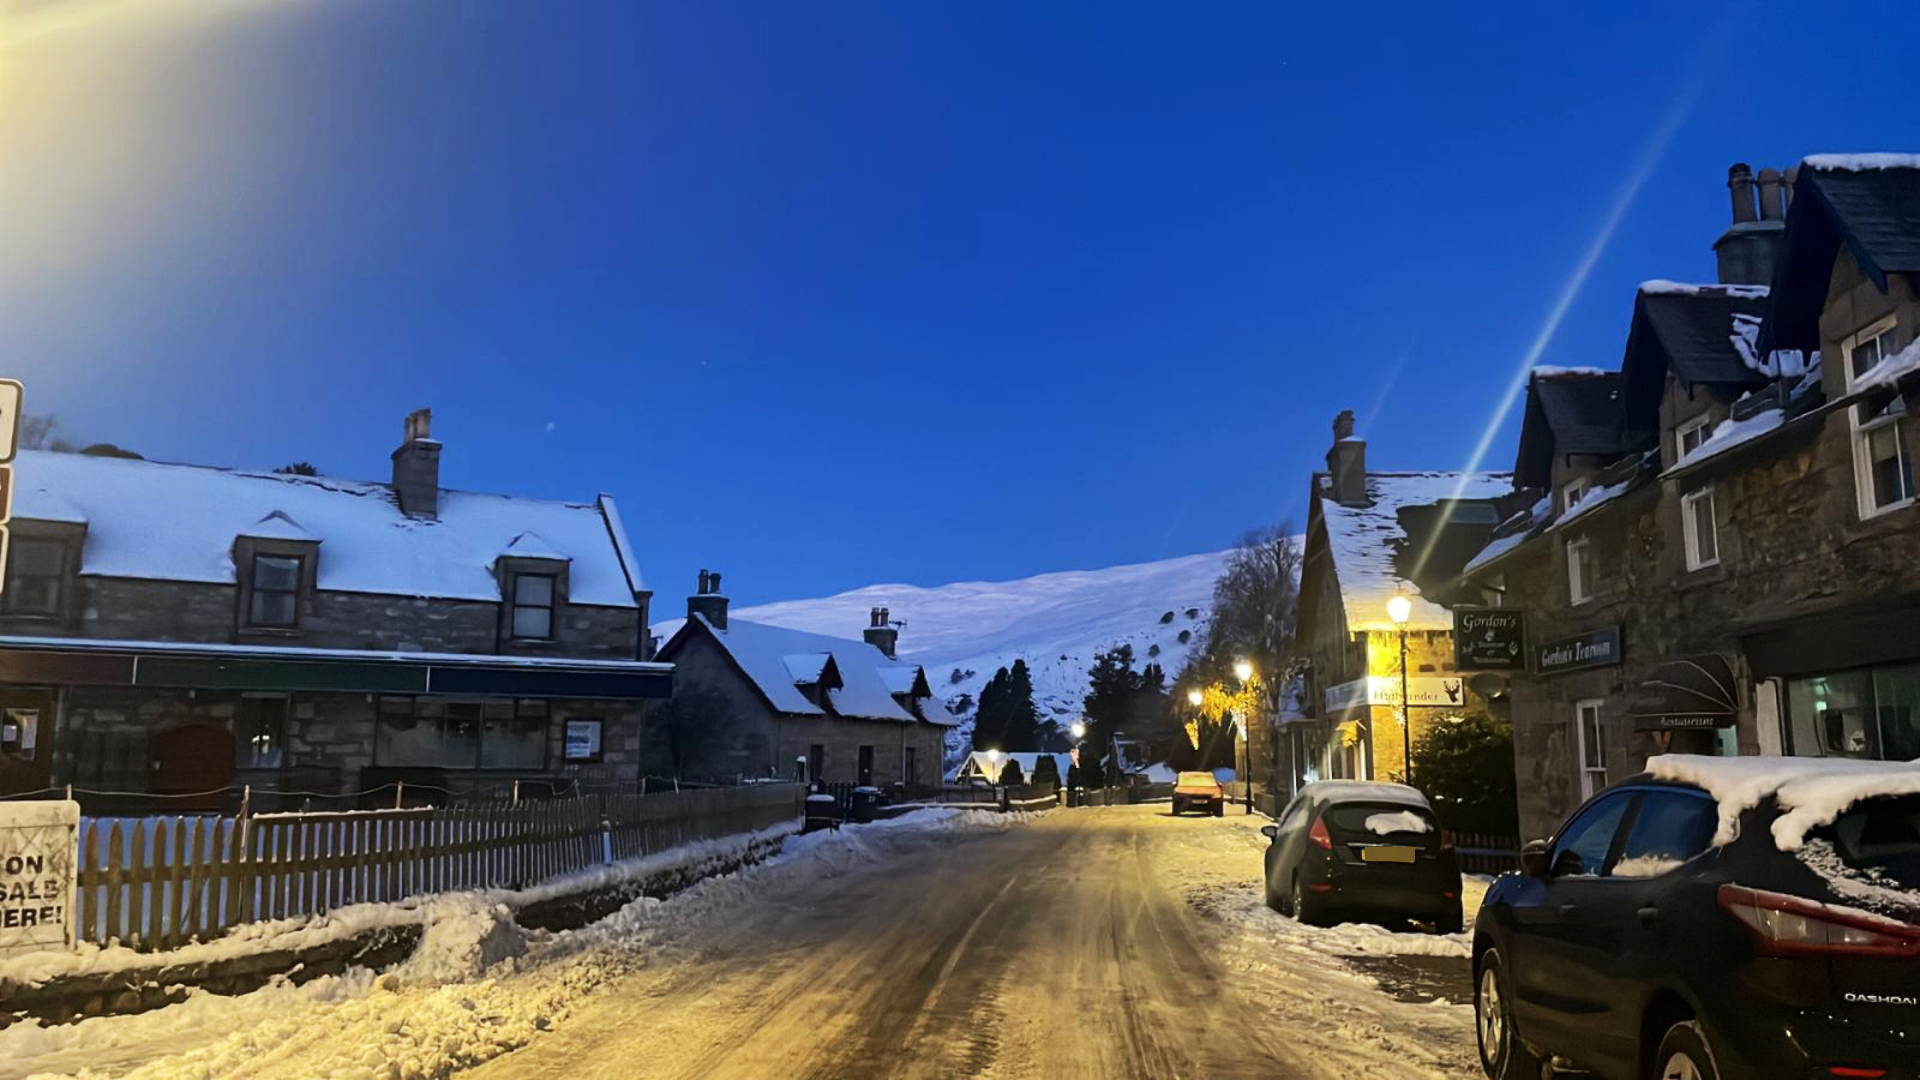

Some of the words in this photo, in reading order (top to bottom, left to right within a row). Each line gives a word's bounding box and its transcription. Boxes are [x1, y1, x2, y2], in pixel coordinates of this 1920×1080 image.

[1463, 613, 1517, 633] Gordon's
[1373, 690, 1438, 702] Highander
[5, 855, 43, 875] ON
[0, 906, 62, 928] ERE!
